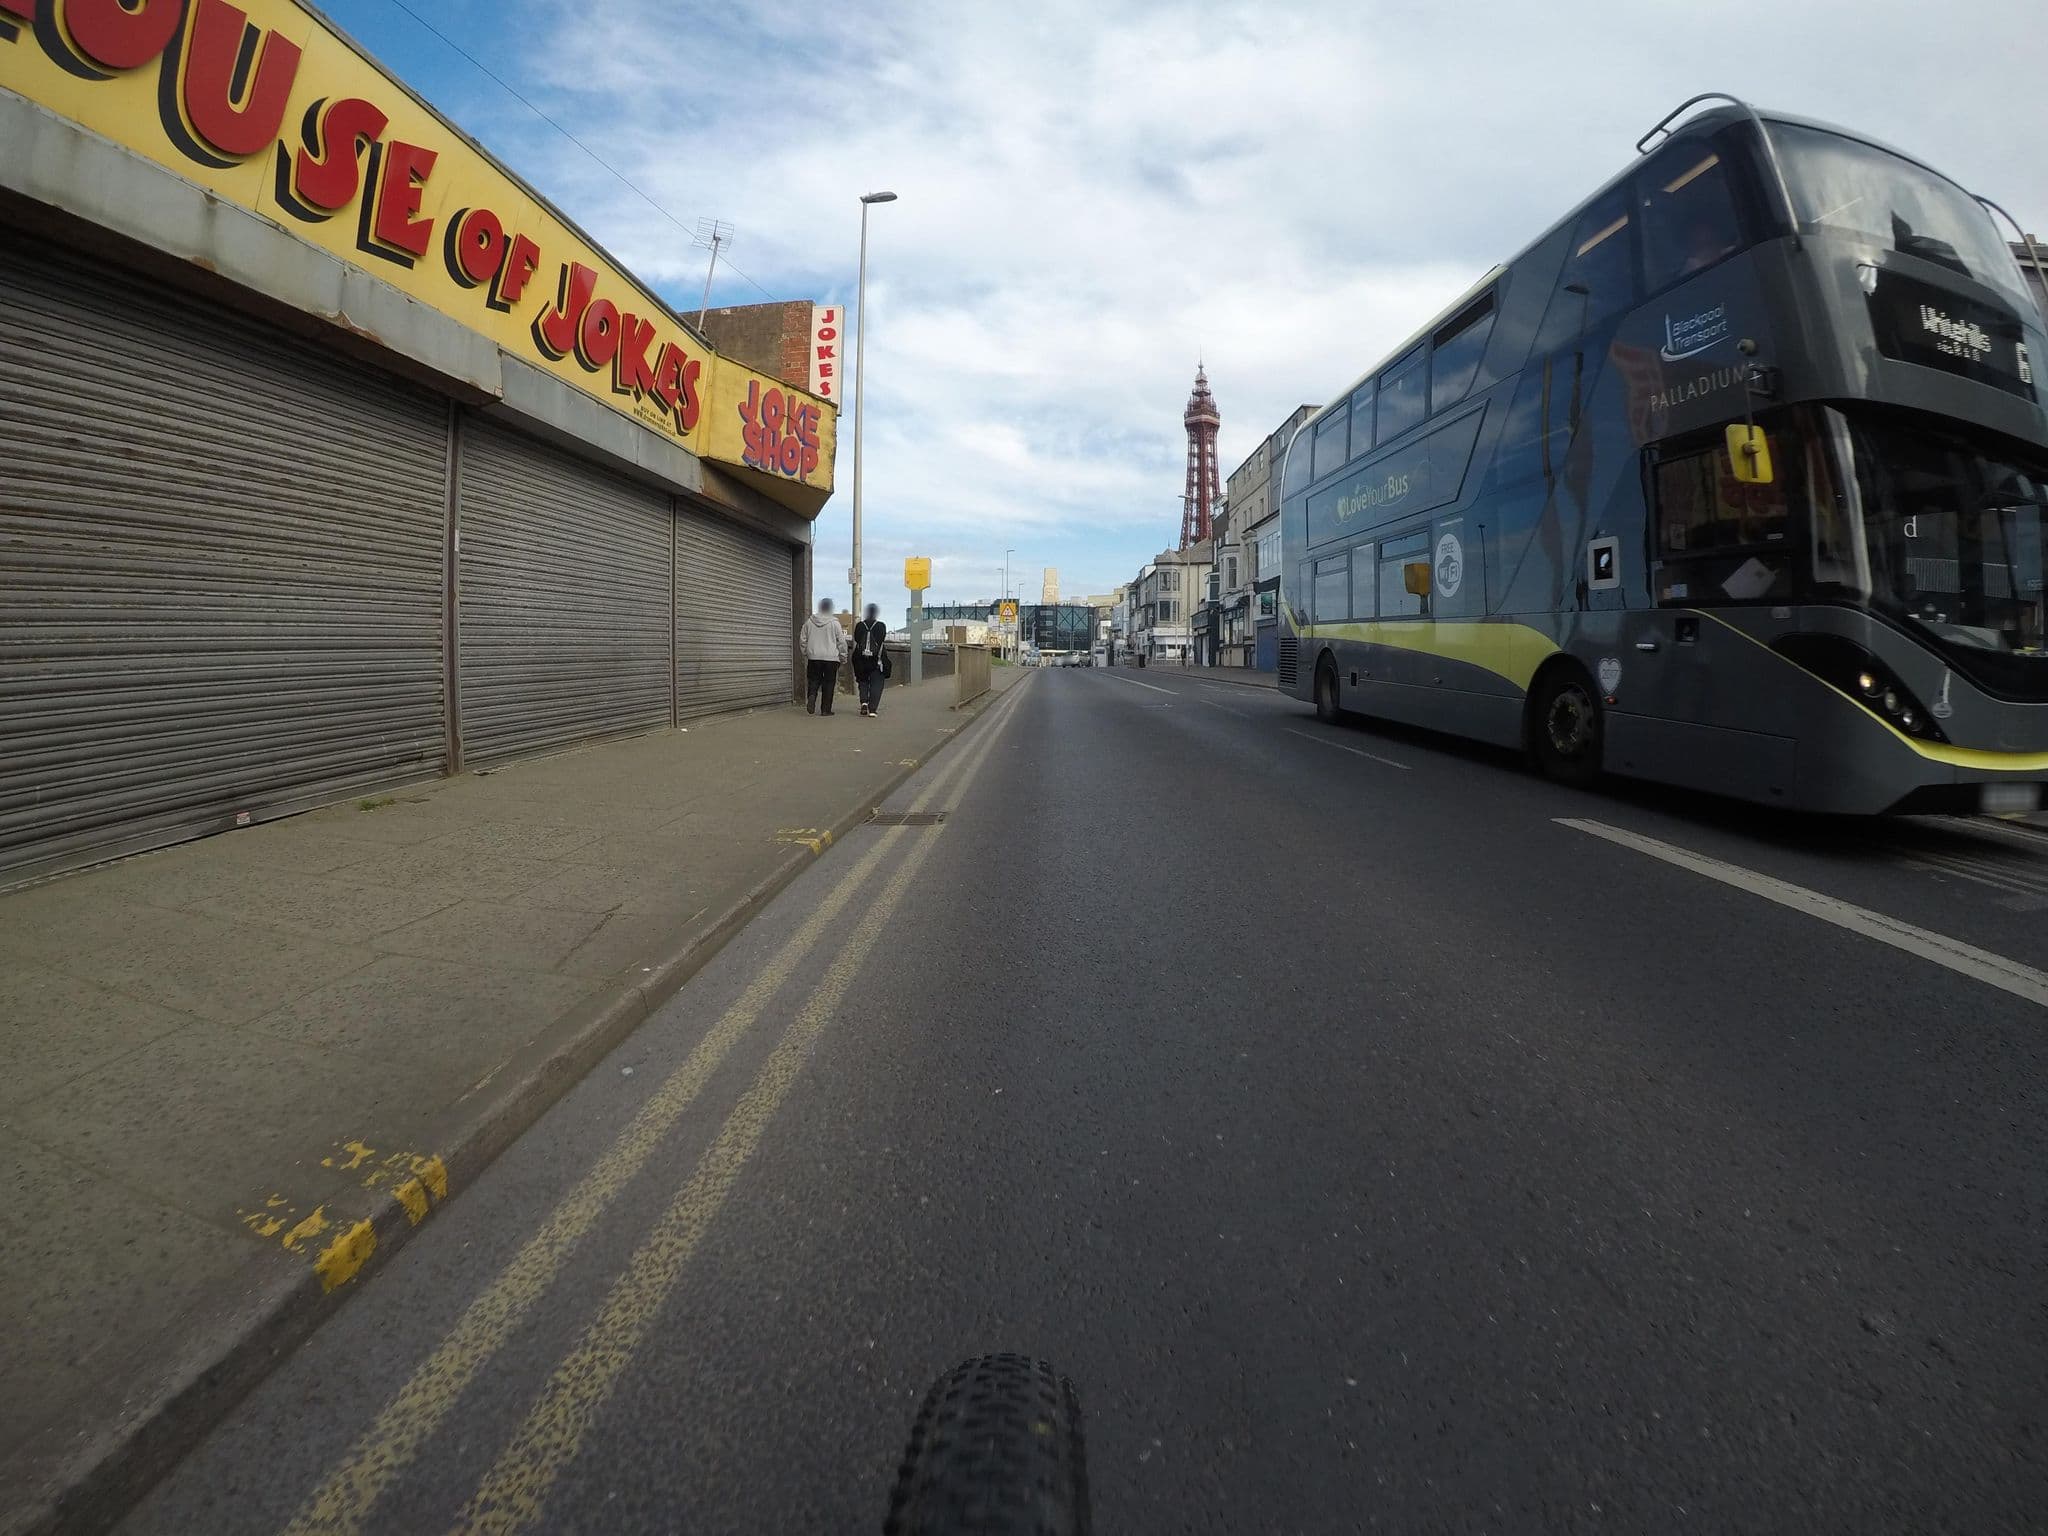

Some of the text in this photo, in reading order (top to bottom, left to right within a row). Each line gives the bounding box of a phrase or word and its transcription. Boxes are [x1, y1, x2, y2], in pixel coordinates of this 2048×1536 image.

[0, 0, 701, 436] OUSE OF JOKES
[817, 309, 836, 396] JOKES
[1672, 302, 1725, 337] Blackpool
[1674, 320, 1728, 350] Transport
[738, 379, 821, 449] JOKE
[741, 420, 818, 482] SHOP
